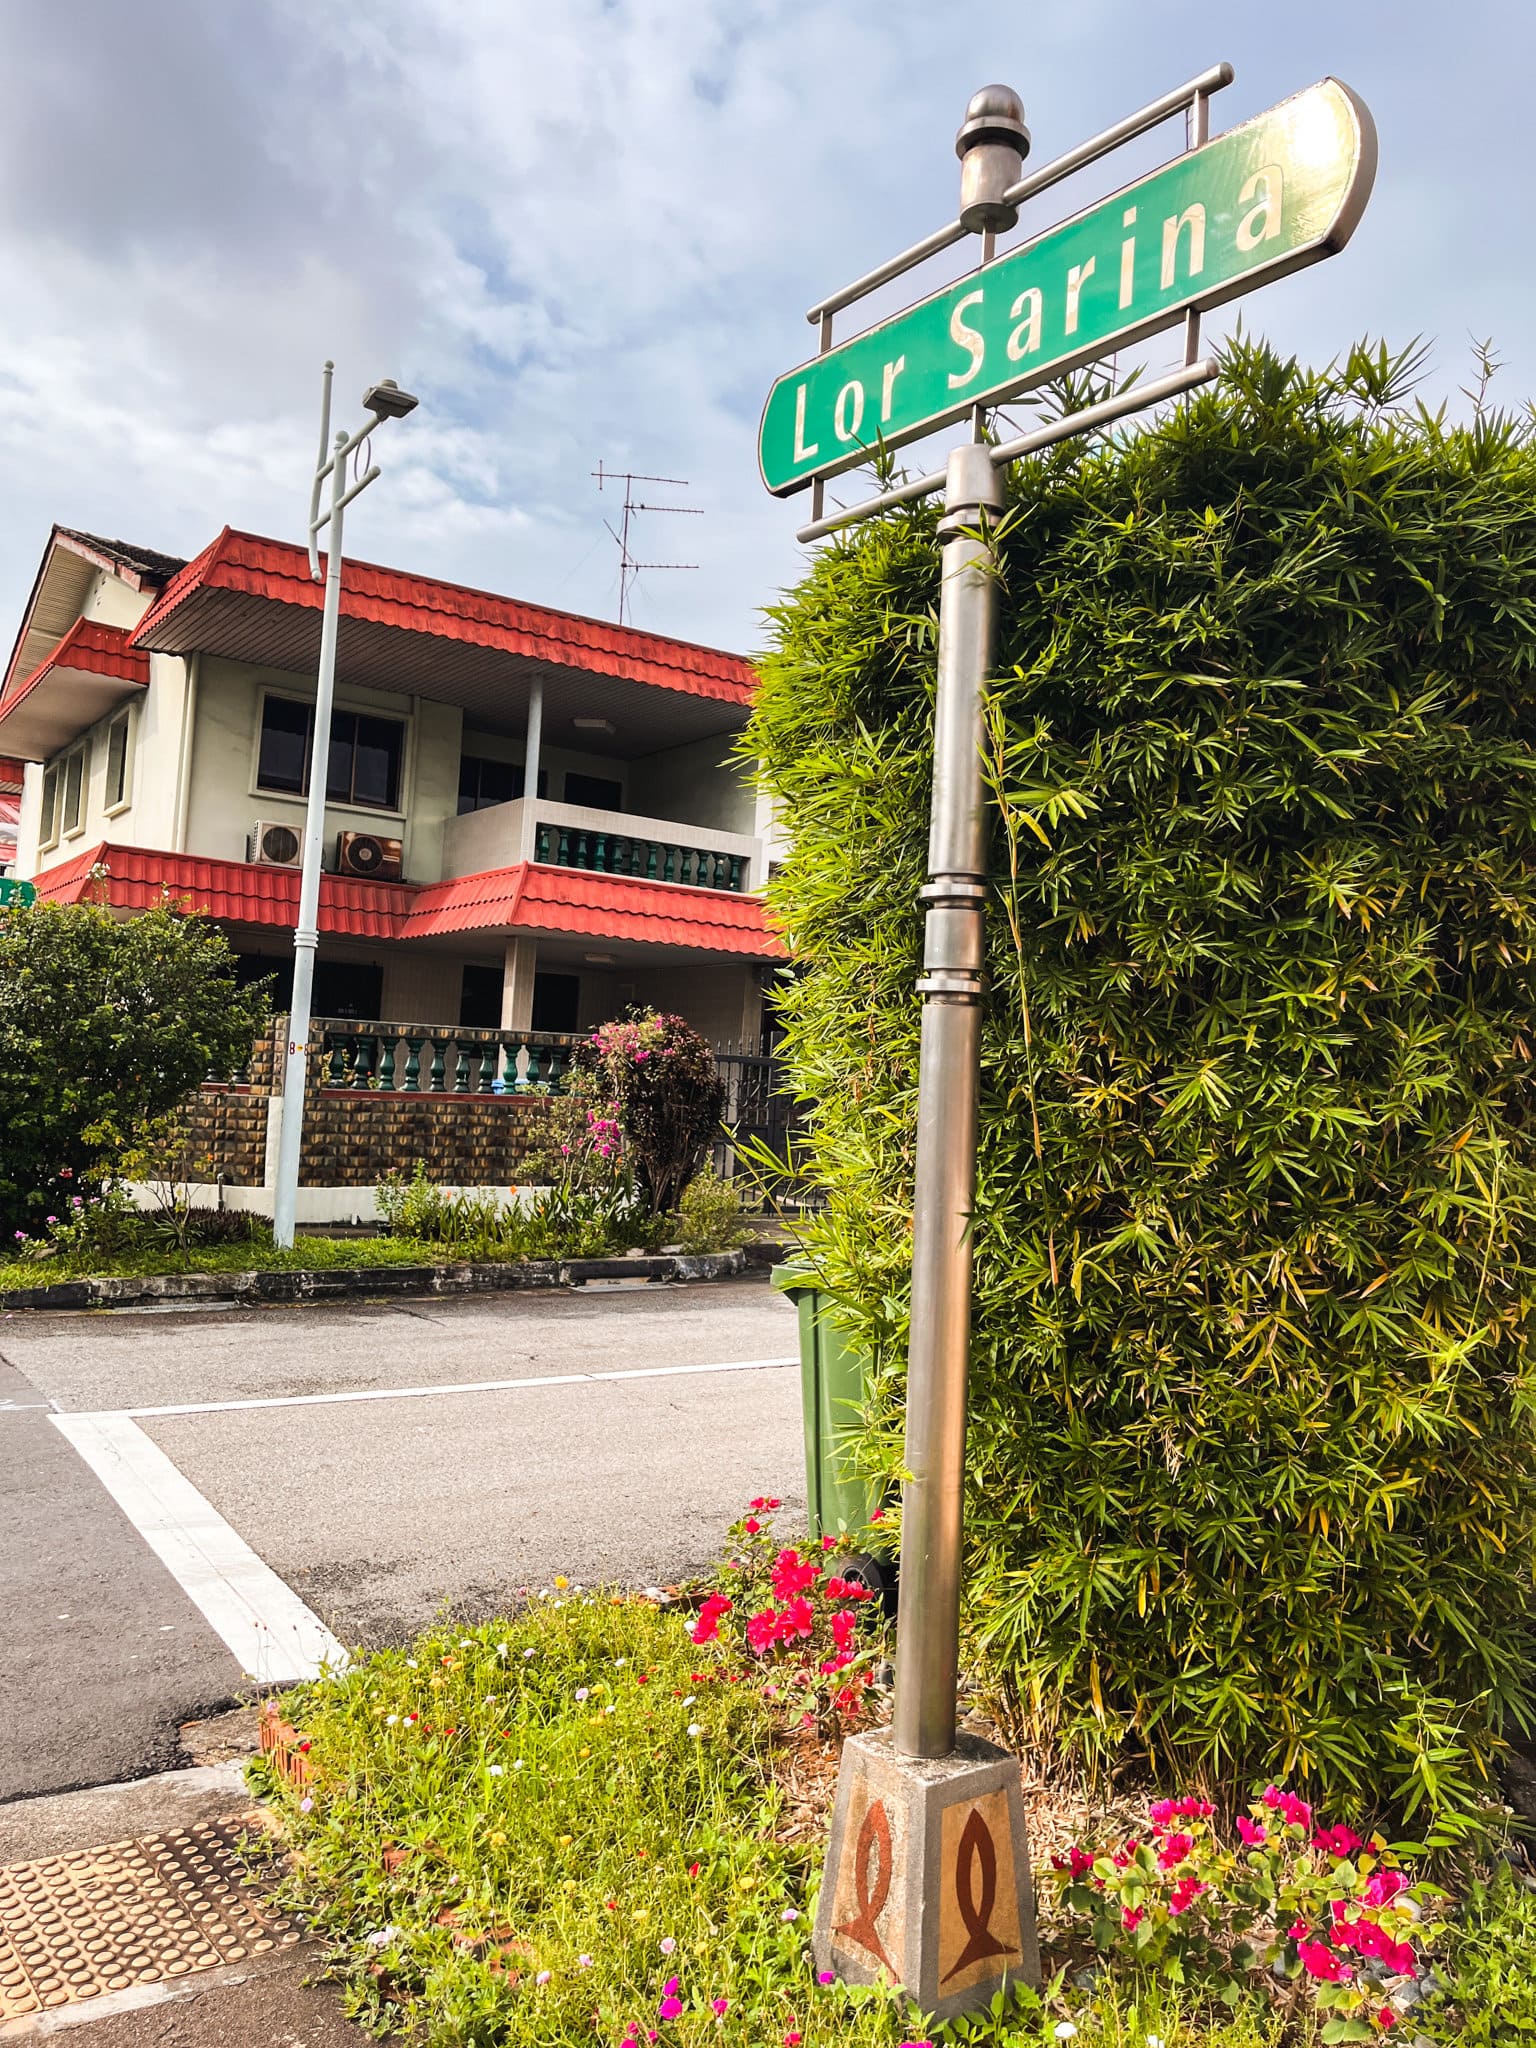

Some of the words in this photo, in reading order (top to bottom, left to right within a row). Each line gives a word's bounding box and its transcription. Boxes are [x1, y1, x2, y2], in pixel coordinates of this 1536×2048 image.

[792, 351, 905, 464] Lor
[947, 163, 1285, 389] Sarina
[289, 1041, 296, 1055] 8
